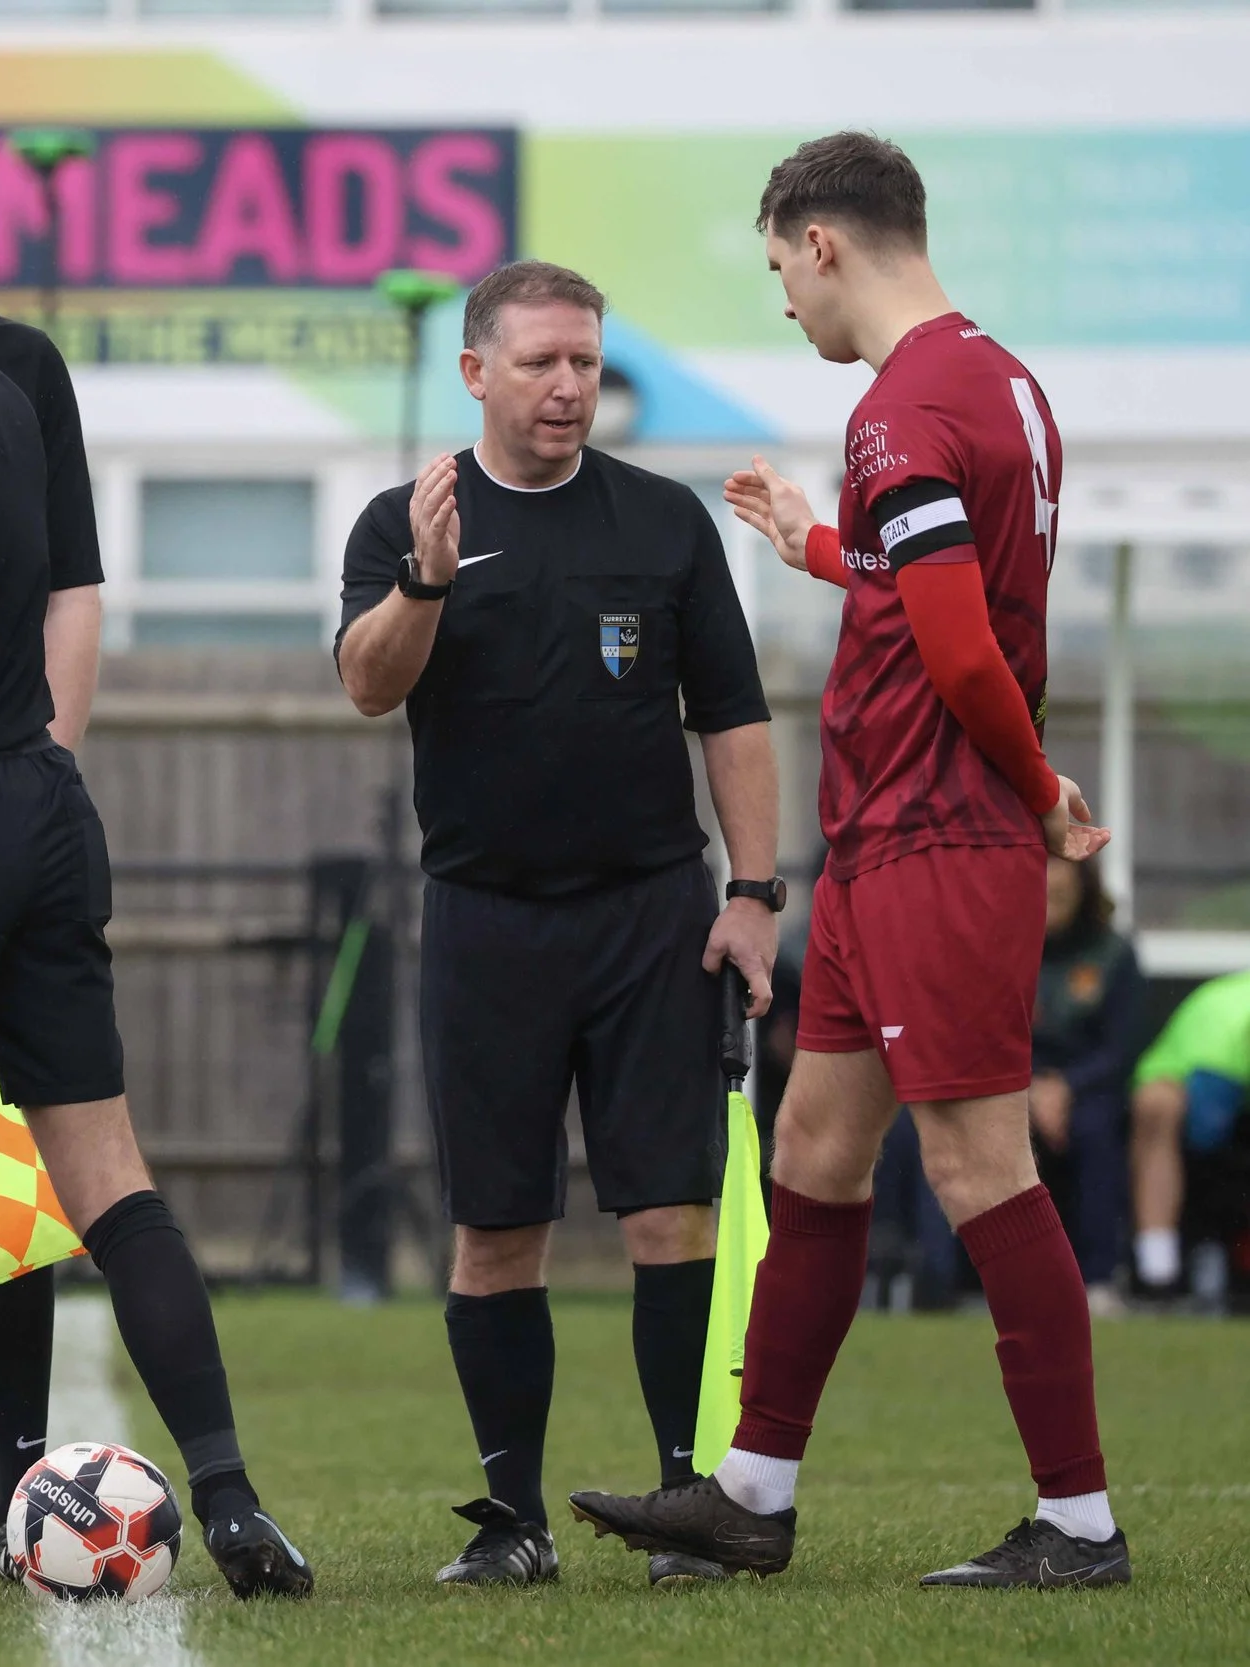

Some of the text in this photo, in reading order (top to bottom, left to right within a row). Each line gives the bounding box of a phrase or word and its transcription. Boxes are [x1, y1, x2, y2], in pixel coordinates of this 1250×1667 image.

[602, 615, 636, 623] SURREY FA
[29, 1475, 97, 1528] uhlsport
